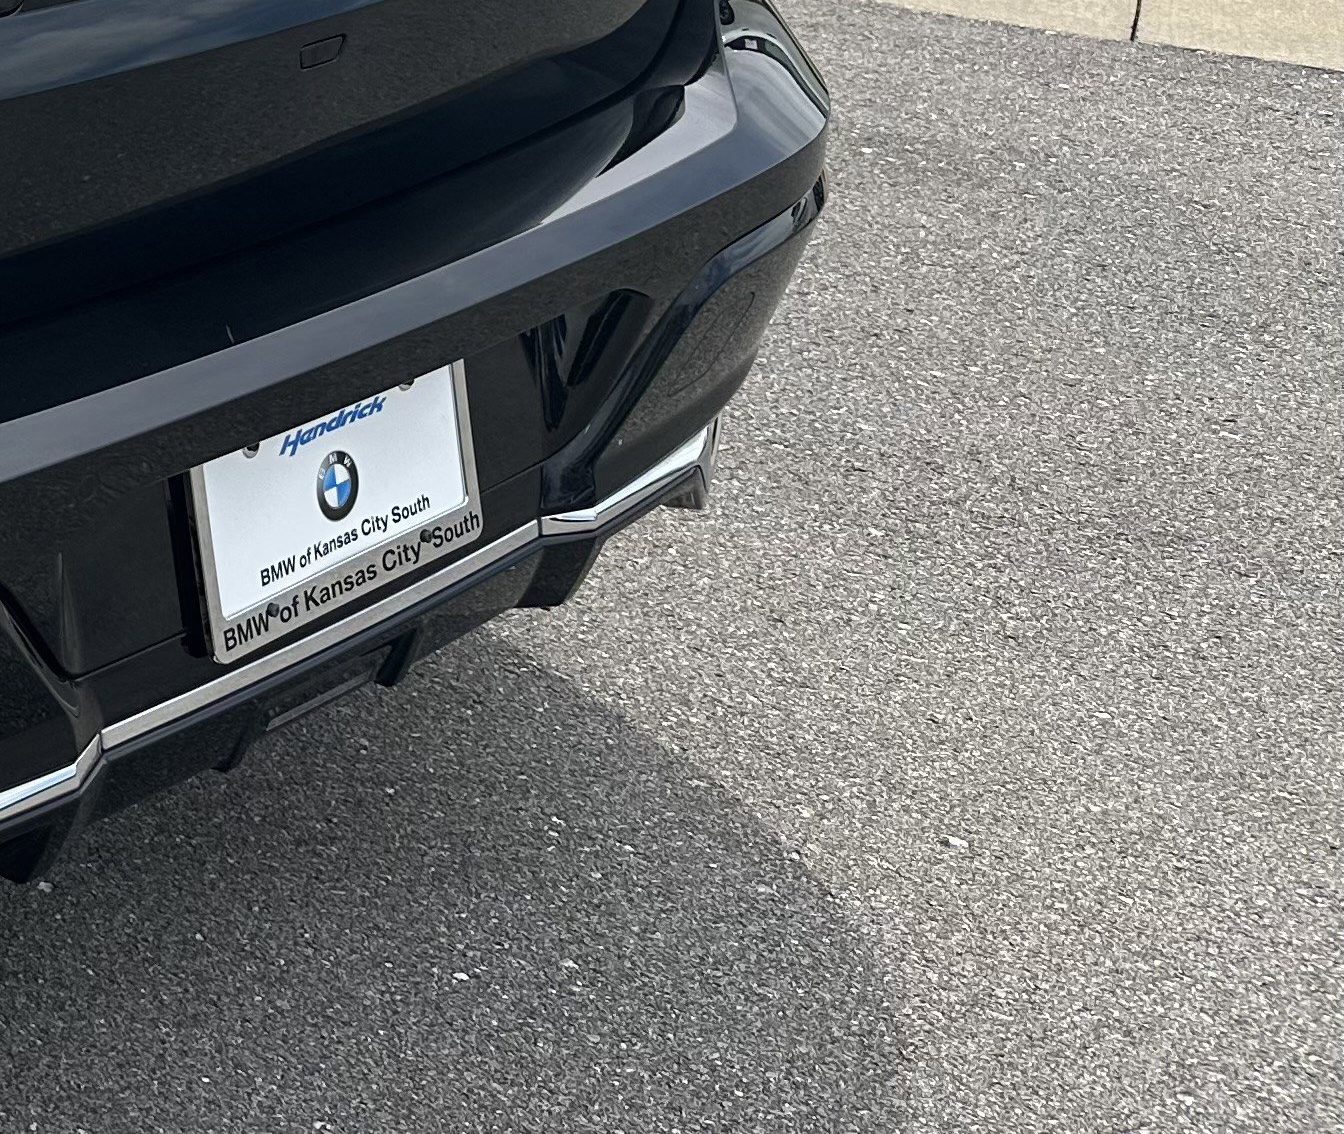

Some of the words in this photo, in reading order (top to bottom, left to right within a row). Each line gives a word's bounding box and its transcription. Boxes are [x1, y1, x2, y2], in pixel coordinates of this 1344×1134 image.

[279, 396, 387, 457] Hendrick
[223, 612, 270, 652] BMW
[280, 594, 299, 623] of
[303, 563, 378, 612] Kansas
[382, 541, 421, 572] City
[432, 511, 480, 548] South
[260, 555, 296, 587] BMW
[299, 547, 311, 568] of
[313, 528, 358, 561] Kansas
[361, 515, 388, 536] City
[391, 494, 430, 524] South
